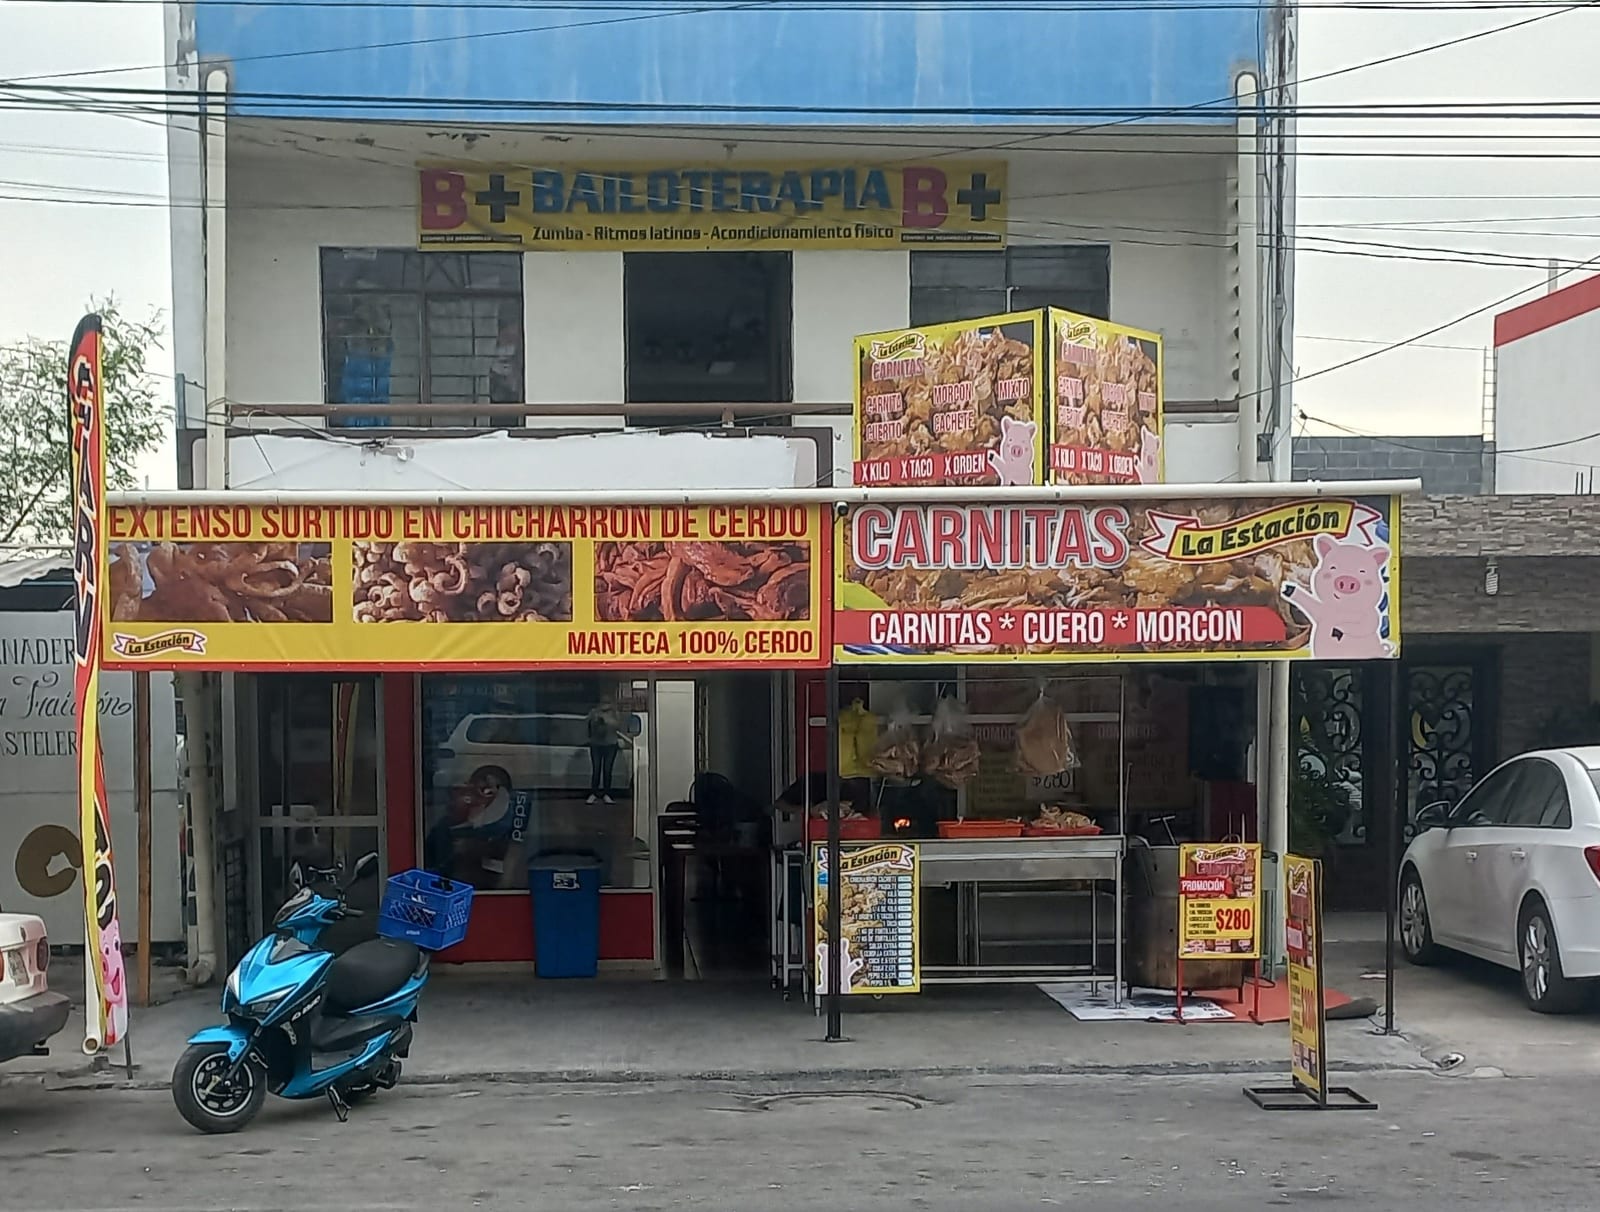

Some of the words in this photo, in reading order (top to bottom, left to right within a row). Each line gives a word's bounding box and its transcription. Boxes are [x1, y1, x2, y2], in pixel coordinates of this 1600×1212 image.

[532, 168, 893, 214] BAILOTERAPIA
[533, 226, 583, 240] Zumba
[594, 226, 647, 241] Ritmos
[650, 226, 701, 240] latinos
[711, 225, 852, 240] Acondicionamiento
[873, 358, 923, 381] CARNITAS
[866, 394, 903, 414] CARNITA
[933, 381, 973, 404] MORCON
[998, 378, 1030, 399] MIXTO
[866, 422, 902, 441] CUERITO
[933, 410, 974, 433] CACHETE
[862, 465, 871, 481] X
[870, 462, 890, 480] KILO
[901, 462, 910, 478] X
[910, 458, 933, 477] TACO
[944, 458, 953, 475] X
[953, 453, 985, 474] ORDEN
[109, 505, 251, 538] EXTENSO
[262, 505, 393, 538] SURTIDO
[403, 505, 442, 538] EN
[452, 505, 651, 538] CHICHARRON
[661, 505, 699, 538] DE
[708, 505, 808, 537] CERDO
[1182, 535, 1213, 556] La
[1220, 505, 1340, 552] Estación
[855, 505, 1128, 568] CARNITAS
[870, 612, 992, 645] CARNITAS
[1022, 612, 1104, 644] CUERO
[1136, 610, 1242, 642] MORCON
[128, 642, 141, 655] La
[143, 634, 190, 653] Estación
[567, 631, 670, 655] MANTECA
[678, 631, 738, 654] 100%
[744, 630, 813, 654] CERDO
[512, 790, 529, 843] pepsi
[850, 849, 898, 868] Estación
[1181, 878, 1225, 891] PROMOCIÓN
[1216, 908, 1251, 932] $280
